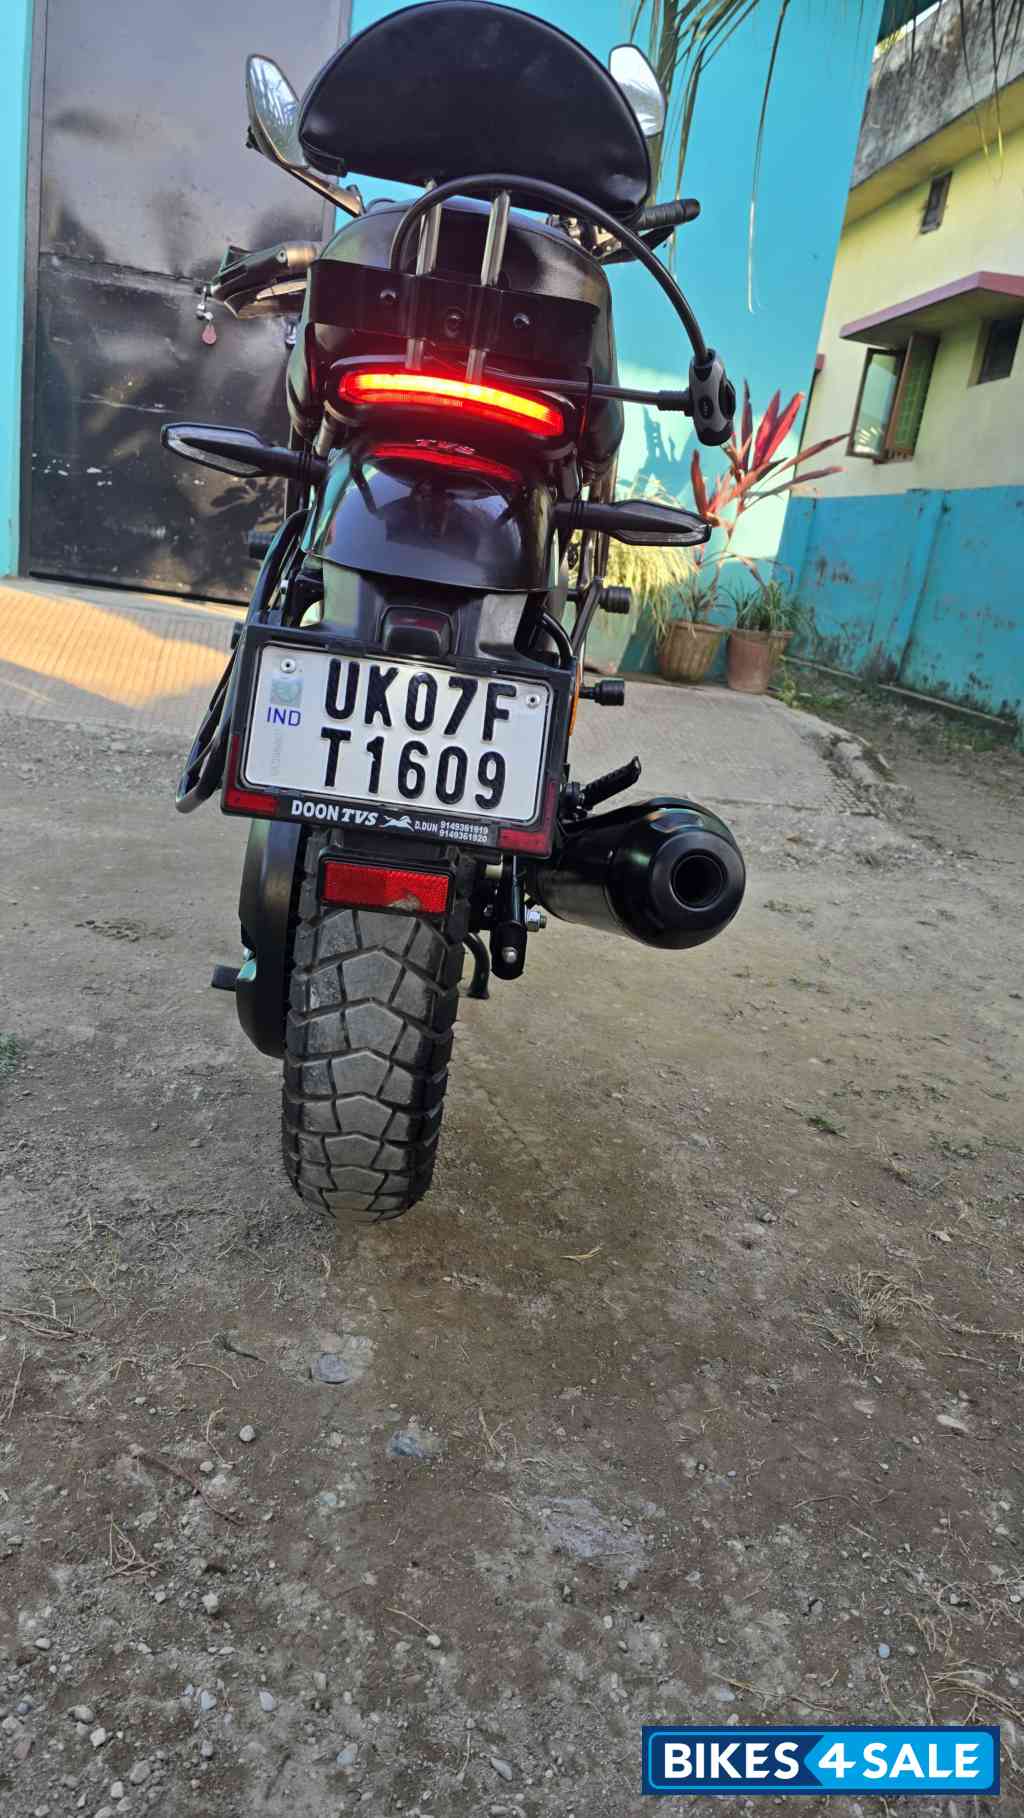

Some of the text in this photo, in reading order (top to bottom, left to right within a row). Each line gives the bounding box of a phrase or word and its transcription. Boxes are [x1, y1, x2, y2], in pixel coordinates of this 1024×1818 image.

[267, 706, 301, 727] IND
[324, 657, 518, 742] UK07F
[320, 726, 507, 810] T1609
[291, 799, 379, 826] DOON TVS
